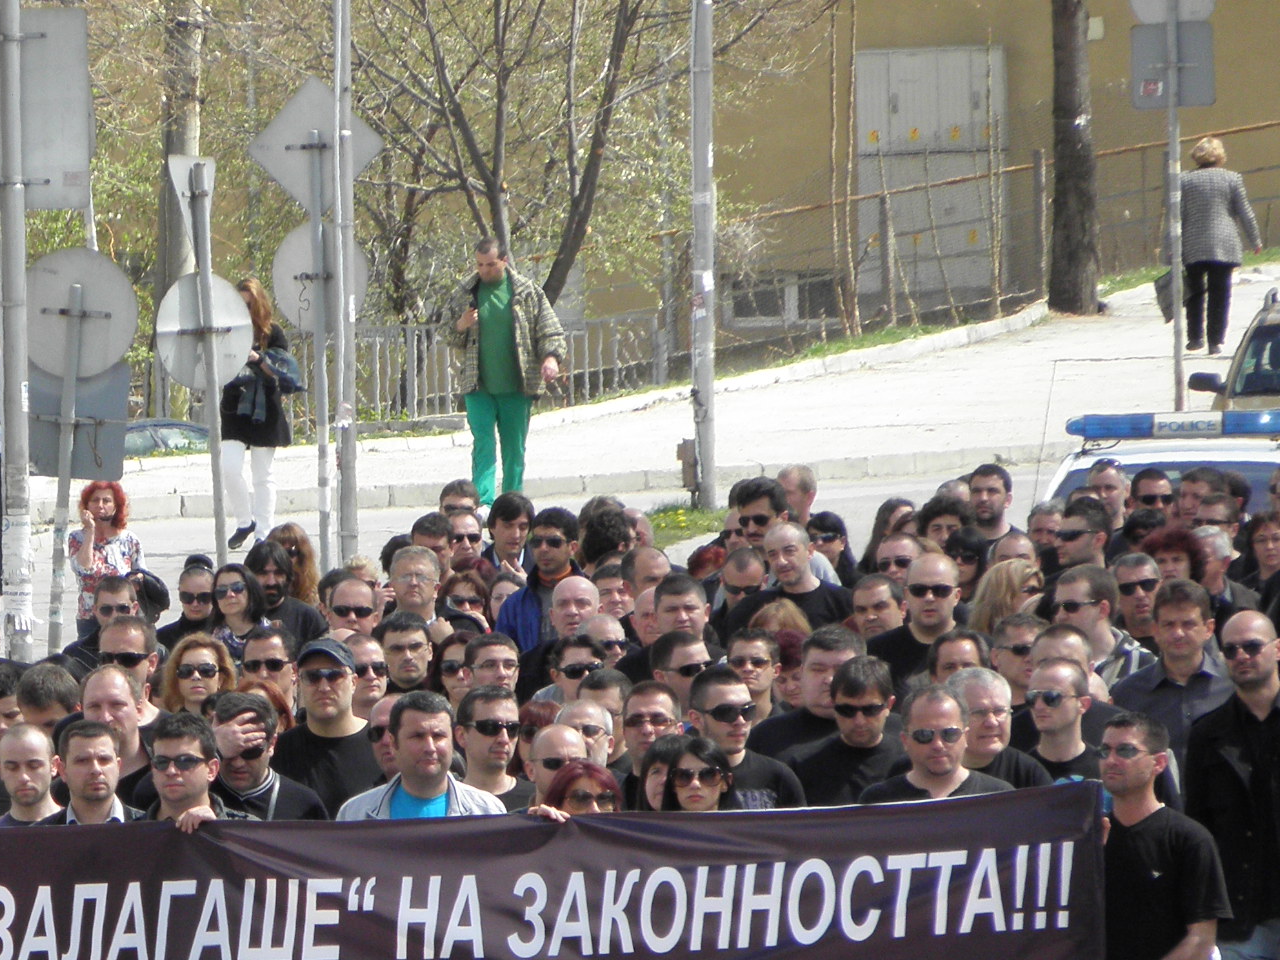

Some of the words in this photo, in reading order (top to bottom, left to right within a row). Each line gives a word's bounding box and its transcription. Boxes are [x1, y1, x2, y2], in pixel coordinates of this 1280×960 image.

[1158, 420, 1217, 433] POLICE
[396, 874, 485, 960] НА
[507, 841, 1075, 959] ЗАКОННОСТТА!!!
